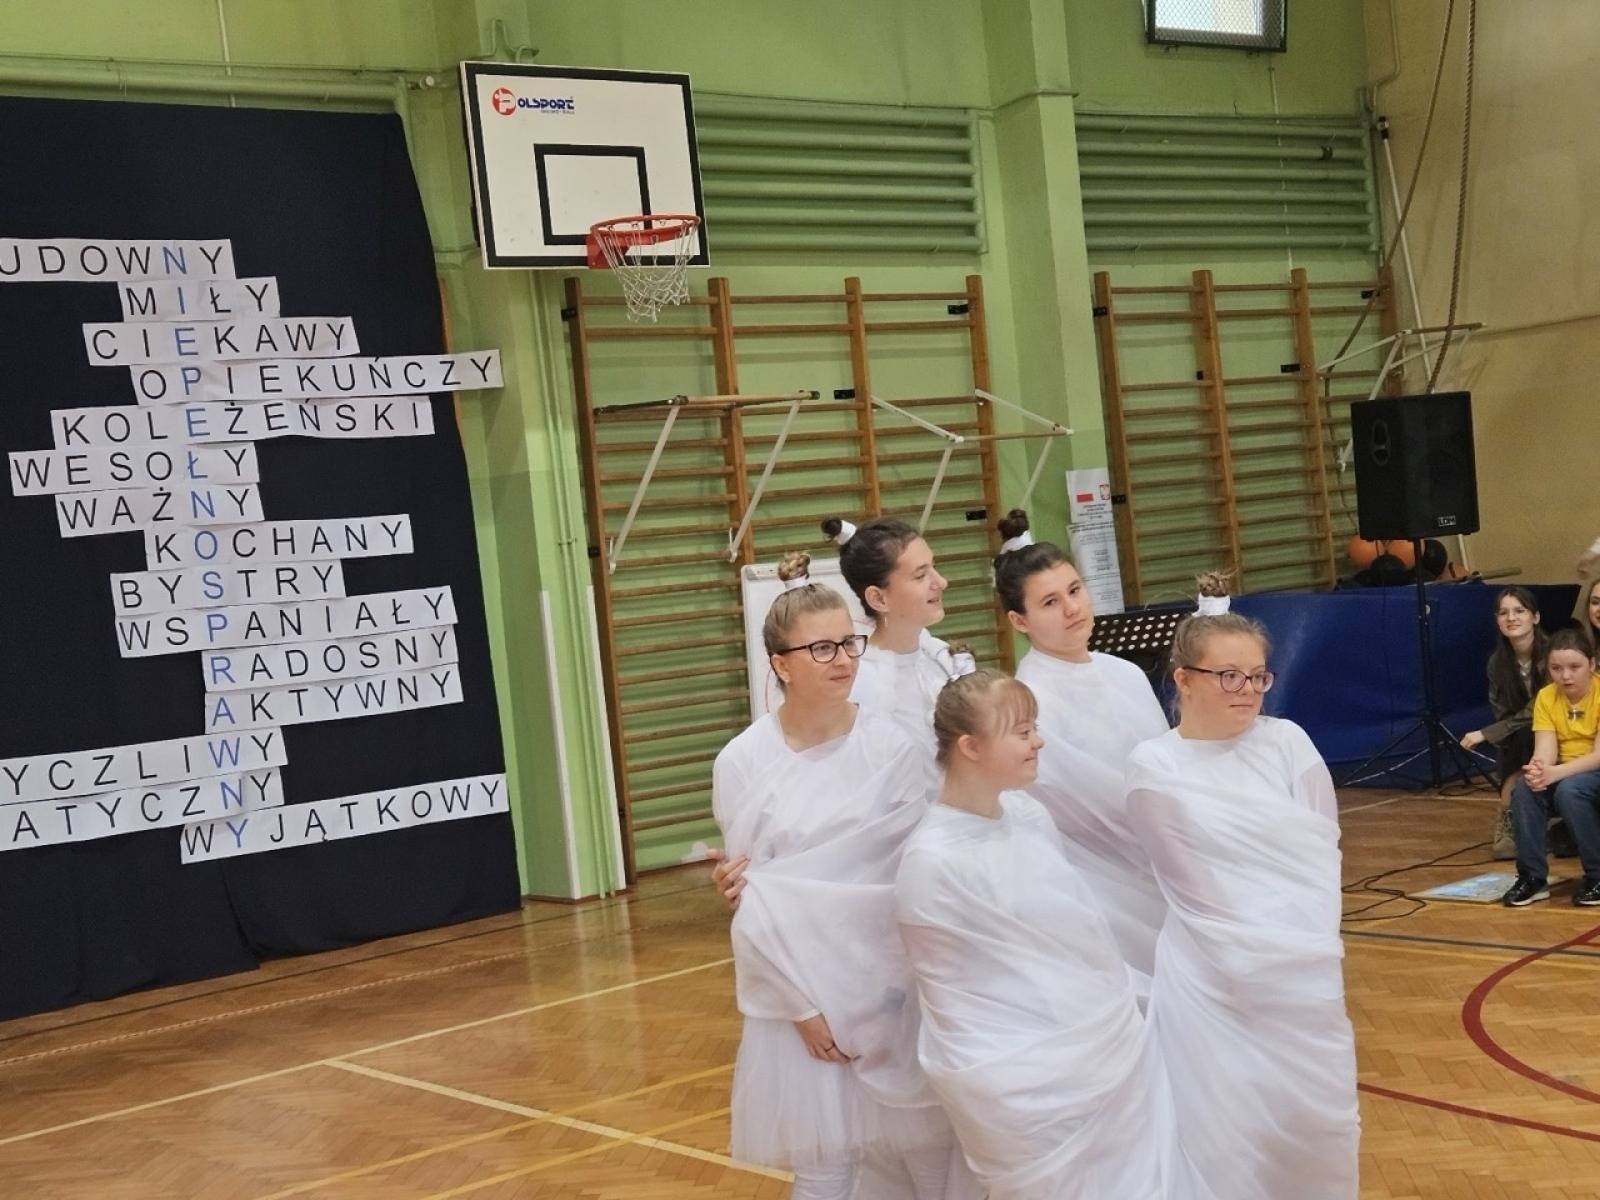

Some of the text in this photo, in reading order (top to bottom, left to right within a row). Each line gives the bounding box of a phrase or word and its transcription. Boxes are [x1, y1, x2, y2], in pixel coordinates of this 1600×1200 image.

[0, 245, 223, 275] UDOWNY
[125, 283, 269, 316] MIŁY
[92, 323, 345, 360] CIEKAWY
[139, 355, 492, 400] OPIEKUŃCZY
[62, 398, 420, 446] KOLEŻEŃSKI
[13, 448, 247, 489] WESOŁY
[59, 486, 250, 530] WAŻNY
[154, 520, 402, 564] KOCHANY
[118, 564, 334, 609] BYSTRY
[118, 592, 444, 651] WSPANIAŁY
[209, 630, 448, 685] RADOSNY
[211, 670, 451, 727] AKTYWNY
[2, 732, 274, 796] YCZLIWY
[11, 771, 272, 842] ATYCZNY
[184, 779, 500, 856] WYJĄTKOWY
